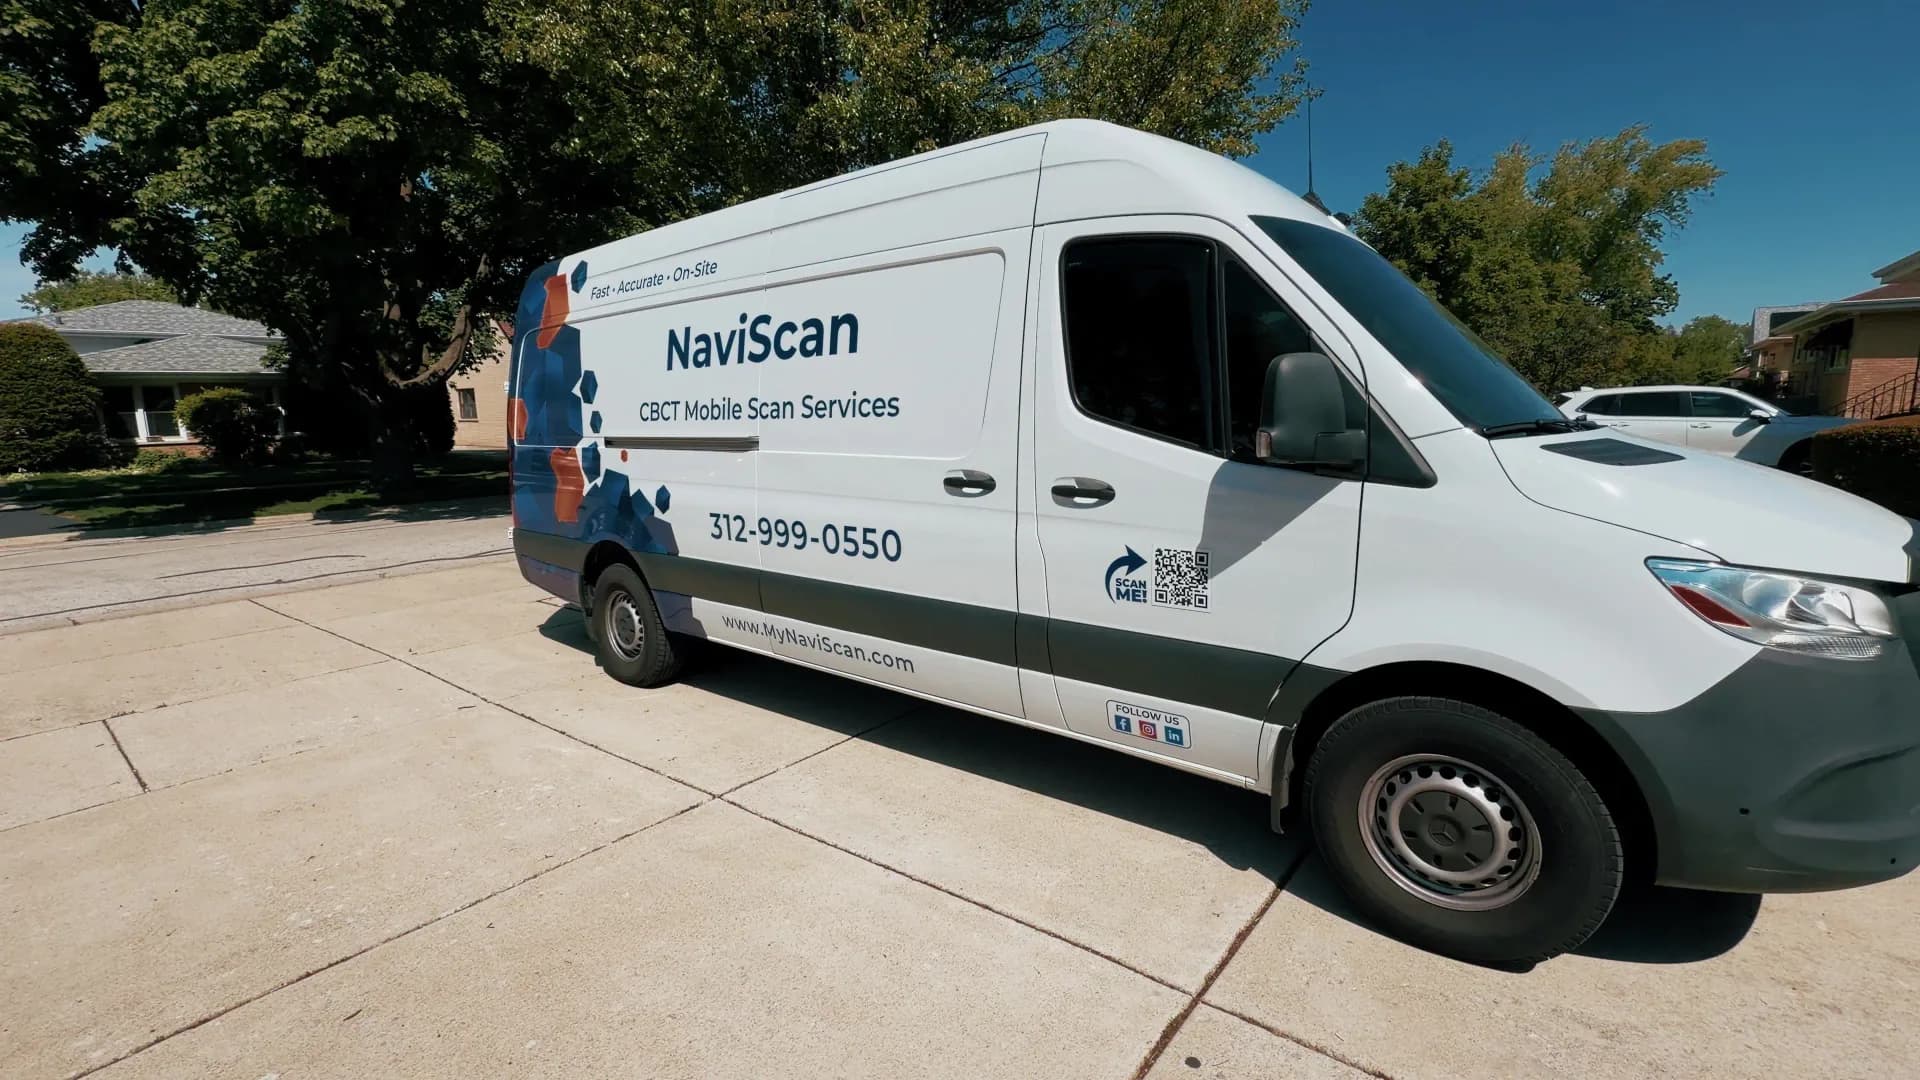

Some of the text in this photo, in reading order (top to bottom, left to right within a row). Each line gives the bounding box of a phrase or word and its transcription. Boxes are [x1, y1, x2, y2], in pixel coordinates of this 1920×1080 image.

[590, 260, 718, 300] Fast Accurate On-Site
[666, 312, 859, 371] NaviScan
[640, 391, 900, 423] CBCT Mobile Scan Services
[710, 512, 901, 562] 312-999-0550
[1116, 578, 1147, 589] SCAN
[1116, 588, 1147, 603] ME!
[722, 614, 915, 673] www.MyNaviScan.com
[1116, 704, 1180, 726] FOLLOW US
[1168, 730, 1180, 742] in
